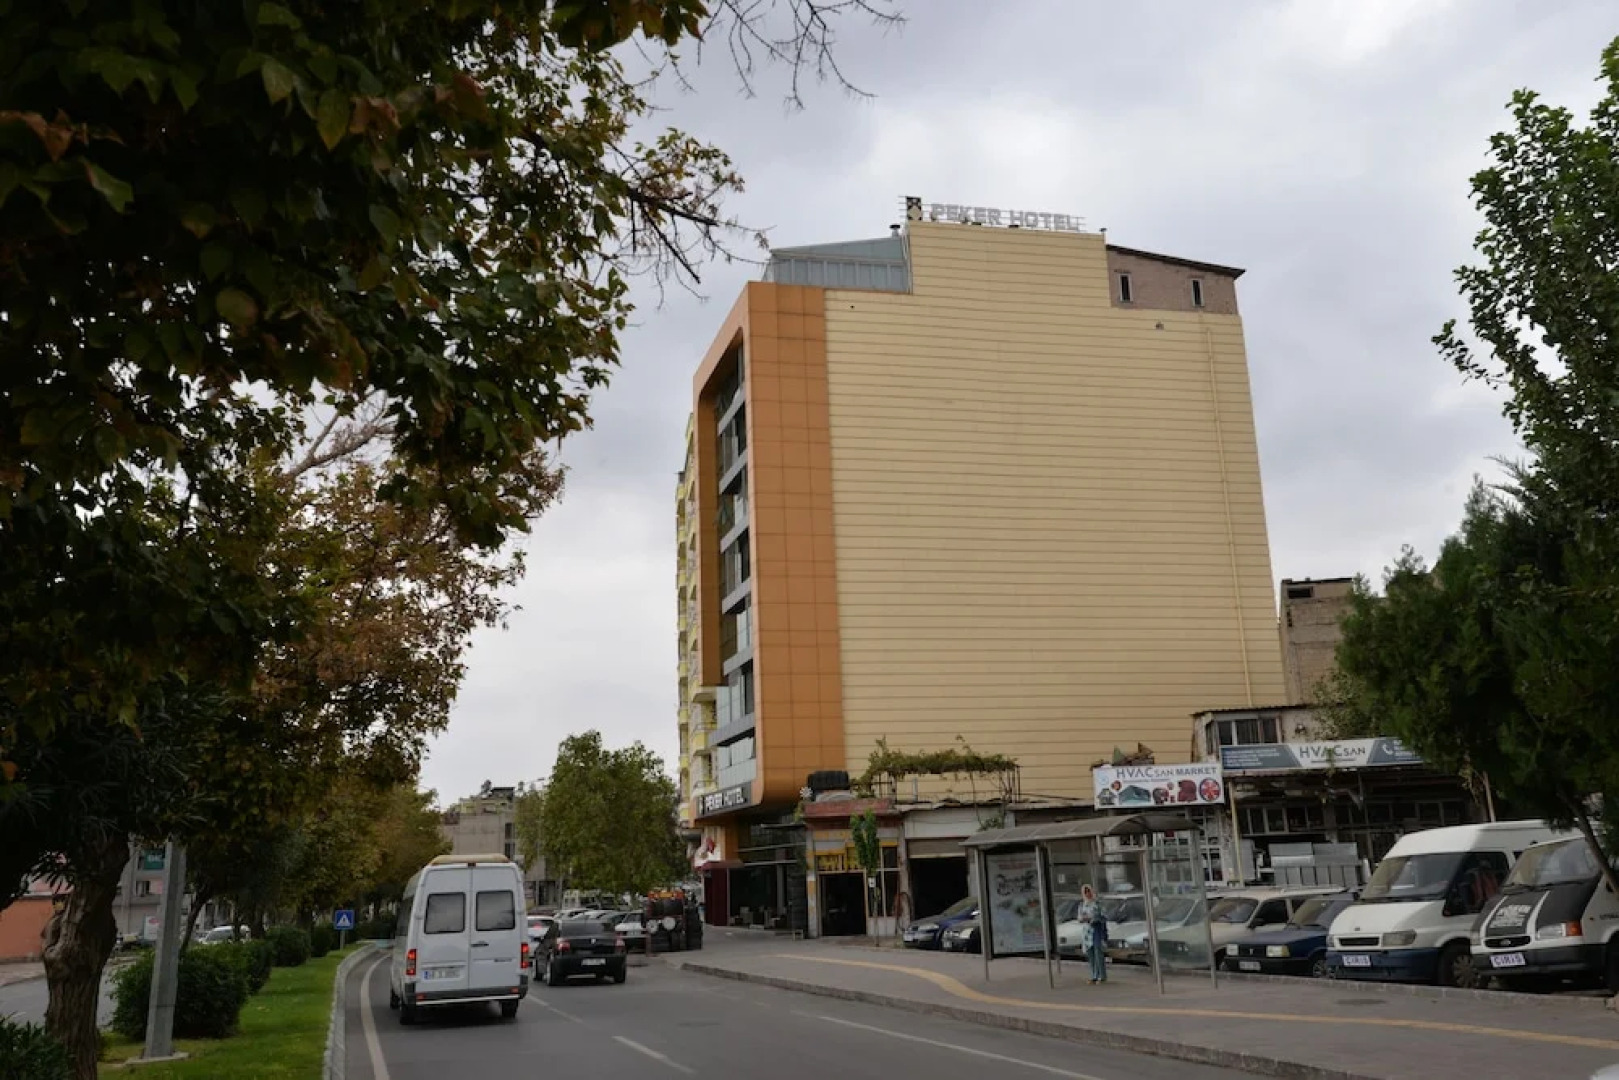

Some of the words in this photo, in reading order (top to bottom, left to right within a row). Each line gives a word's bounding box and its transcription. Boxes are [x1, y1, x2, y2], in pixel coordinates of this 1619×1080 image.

[931, 203, 1000, 225] PEKER
[1010, 209, 1078, 230] HOTEL
[1175, 767, 1217, 776] MARKET
